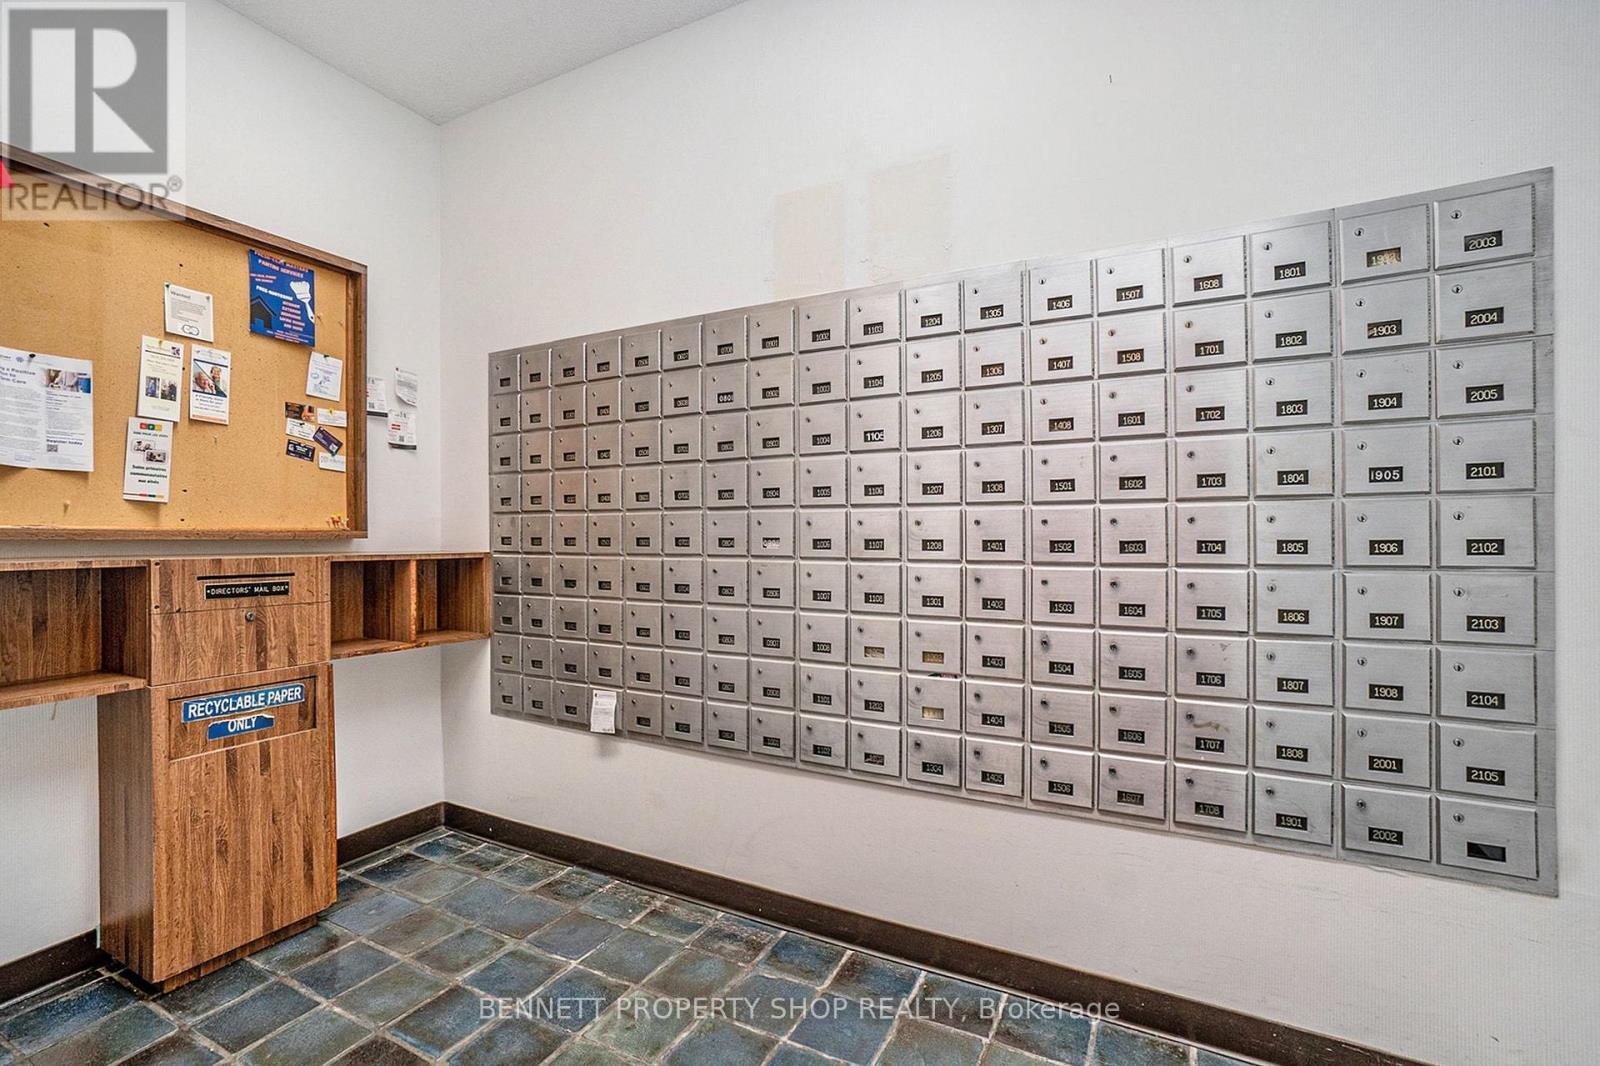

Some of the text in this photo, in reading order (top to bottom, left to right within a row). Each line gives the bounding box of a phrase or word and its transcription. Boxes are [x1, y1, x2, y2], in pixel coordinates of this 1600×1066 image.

[1469, 236, 1496, 250] 2003
[1280, 267, 1300, 278] 1801
[1200, 279, 1219, 290] 1608
[1122, 289, 1140, 300] 1507
[1053, 299, 1070, 309] 1406
[986, 308, 1002, 318] 1305
[1470, 312, 1497, 324] 2004
[925, 317, 940, 326] 1204
[868, 325, 882, 334] 1103
[1373, 325, 1396, 336] 1903
[816, 332, 829, 341] 1002
[1281, 335, 1302, 346] 1802
[1200, 344, 1219, 355] 1701
[1122, 352, 1141, 362] 1508
[1054, 360, 1070, 369] 1407
[986, 366, 1002, 376] 1306
[926, 372, 941, 382] 1205
[868, 379, 882, 387] 1104
[817, 385, 830, 393] 1003
[1471, 389, 1498, 401] 2005
[1374, 397, 1396, 408] 1904
[1282, 404, 1303, 414] 1803
[1124, 415, 1141, 425] 1601
[1201, 410, 1221, 420] 1702
[987, 424, 1002, 433] 1307
[1054, 421, 1071, 430] 1408
[927, 429, 942, 437] 1206
[1371, 470, 1400, 480] 1905
[1471, 466, 1496, 477] 2101
[1202, 477, 1222, 486] 1703
[1283, 474, 1304, 483] 1804
[987, 484, 1003, 492] 1308
[1055, 482, 1072, 490] 1501
[1124, 480, 1143, 488] 1602
[927, 486, 942, 494] 1207
[1054, 543, 1072, 551] 1502
[1124, 543, 1143, 552] 1603
[1202, 543, 1222, 552] 1704
[1282, 543, 1304, 552] 1805
[1374, 543, 1398, 553] 1906
[1471, 543, 1498, 553] 2102
[927, 598, 941, 606] 1301
[987, 600, 1003, 609] 1402
[1055, 603, 1072, 612] 1503
[1124, 606, 1142, 615] 1604
[1202, 608, 1222, 618] 1705
[1283, 612, 1305, 622] 1806
[1375, 616, 1398, 626] 1907
[1472, 618, 1498, 630] 2103
[987, 658, 1003, 666] 1403
[1054, 664, 1071, 673] 1504
[1124, 669, 1142, 679] 1605
[1201, 674, 1221, 685] 1706
[1283, 680, 1304, 691] 1807
[1375, 687, 1398, 698] 1908
[188, 687, 301, 718] RECYCLABLE PAPER
[1472, 694, 1498, 706] 2104
[869, 702, 882, 710] 1202
[228, 717, 257, 732] ONLY
[987, 716, 1002, 725] 1404
[1054, 724, 1071, 734] 1505
[1124, 731, 1142, 742] 1606
[1200, 739, 1220, 750] 1707
[1282, 748, 1303, 759] 1808
[926, 764, 941, 773] 1304
[1374, 758, 1393, 770] 2001
[986, 773, 1002, 783] 1405
[1472, 769, 1498, 782] 2105
[1053, 783, 1070, 793] 1506
[1122, 792, 1140, 804] 1607
[1199, 804, 1220, 816] 1708
[1281, 816, 1302, 828] 1901
[1373, 829, 1397, 842] 2002
